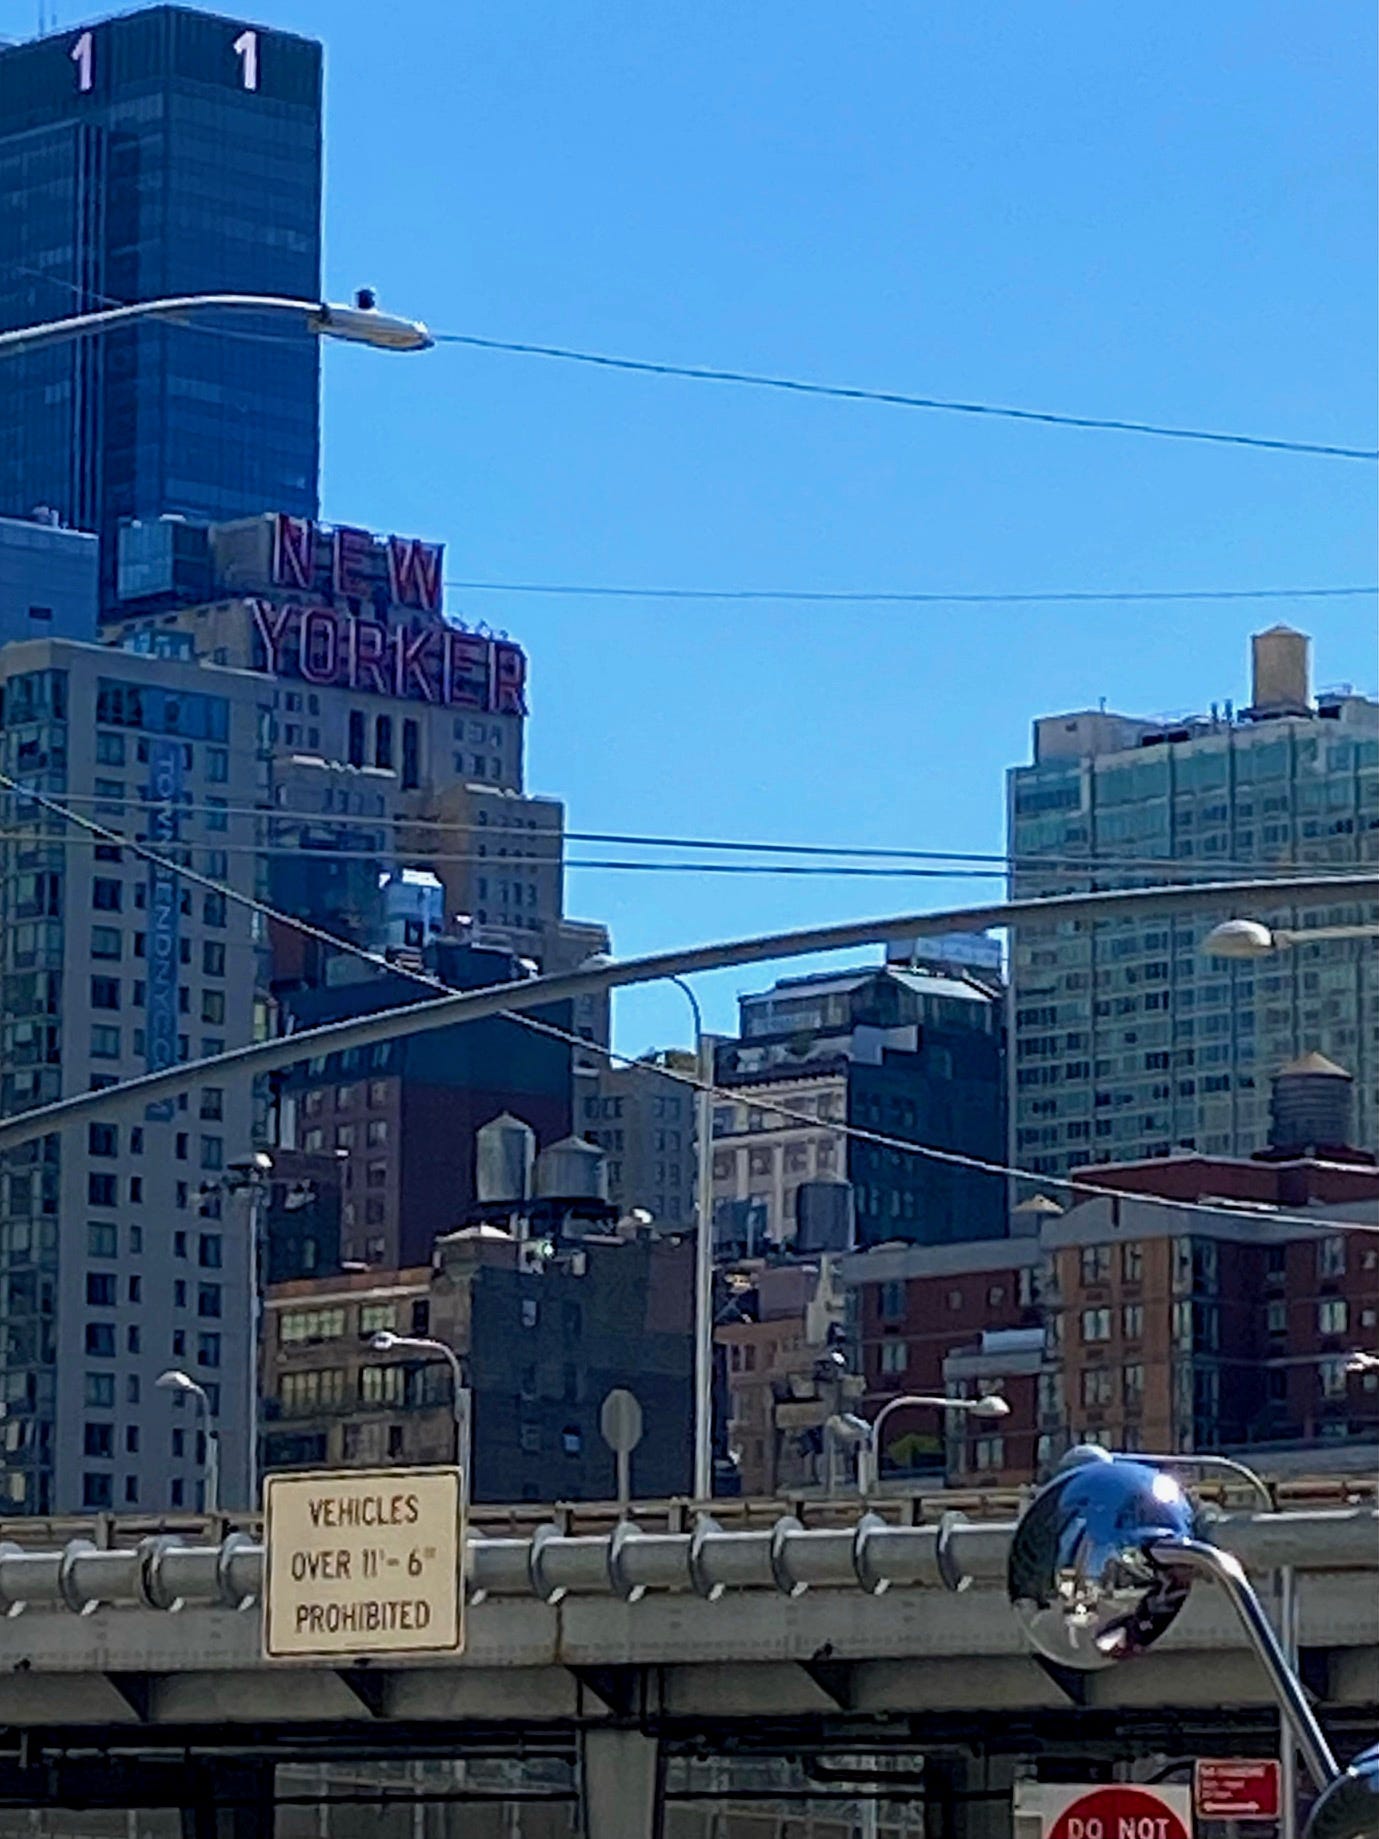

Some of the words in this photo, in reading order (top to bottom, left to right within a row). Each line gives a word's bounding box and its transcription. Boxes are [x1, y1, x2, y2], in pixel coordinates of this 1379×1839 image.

[70, 31, 93, 91] 1
[233, 30, 257, 90] 1
[273, 512, 446, 611] NEW
[248, 598, 528, 715] YORKER
[309, 1494, 419, 1527] VEHICLES
[291, 1550, 351, 1582] OVER
[295, 1600, 431, 1633] PROHIBITED
[1068, 1817, 1103, 1839] DO
[1118, 1816, 1169, 1839] NOT
